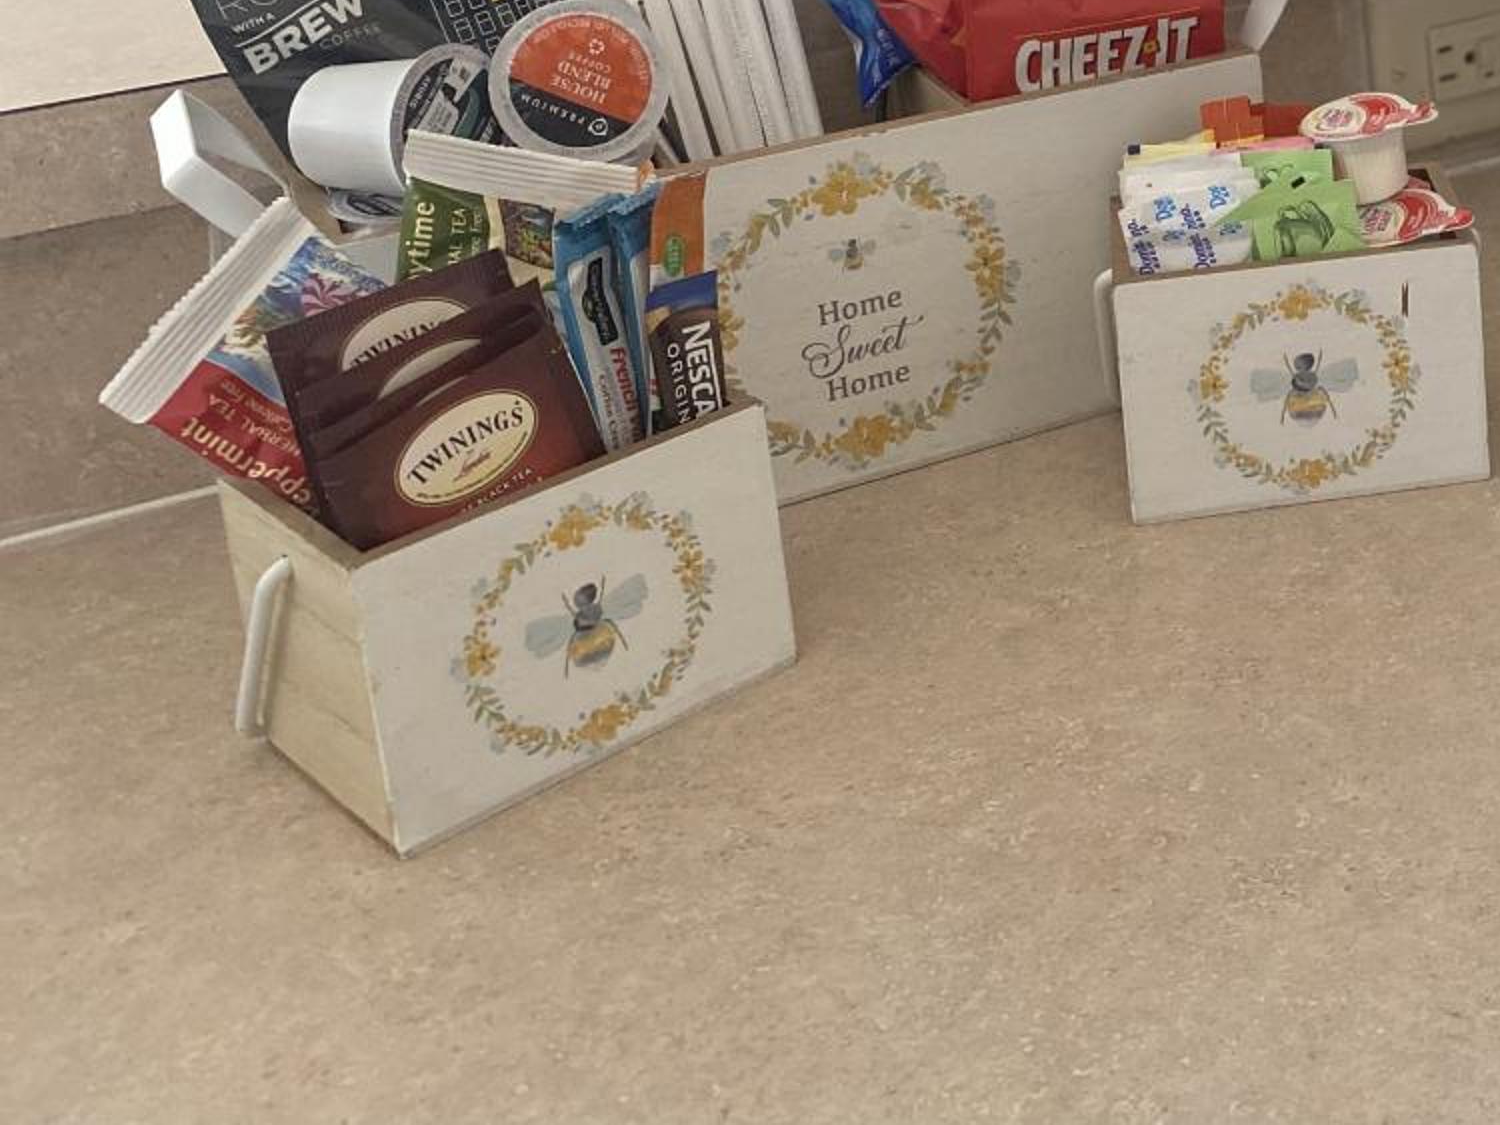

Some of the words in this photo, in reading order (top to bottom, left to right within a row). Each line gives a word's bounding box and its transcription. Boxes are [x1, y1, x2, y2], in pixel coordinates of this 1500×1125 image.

[817, 290, 902, 326] Home
[801, 315, 924, 379] Sweet
[208, 393, 237, 422] TEA
[826, 365, 911, 402] Home
[180, 416, 316, 510] eppermint
[407, 406, 525, 484] TWININGS
